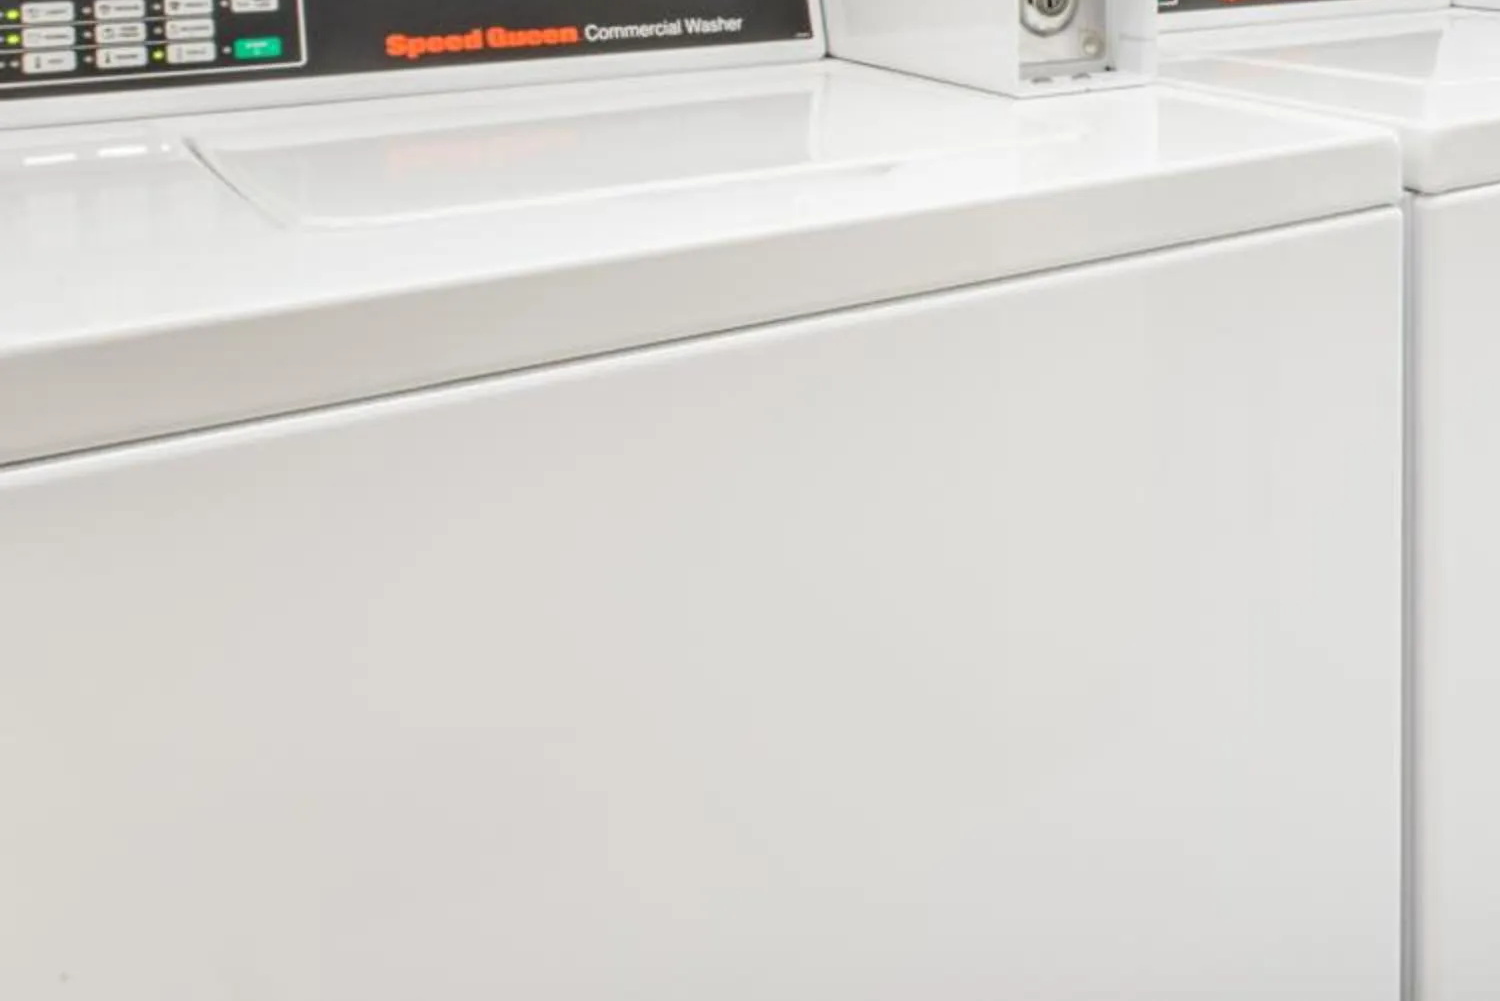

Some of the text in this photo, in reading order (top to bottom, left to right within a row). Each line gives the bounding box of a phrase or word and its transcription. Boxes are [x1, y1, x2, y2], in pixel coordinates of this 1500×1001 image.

[385, 15, 743, 59] Speed Queen Commercial Washer
